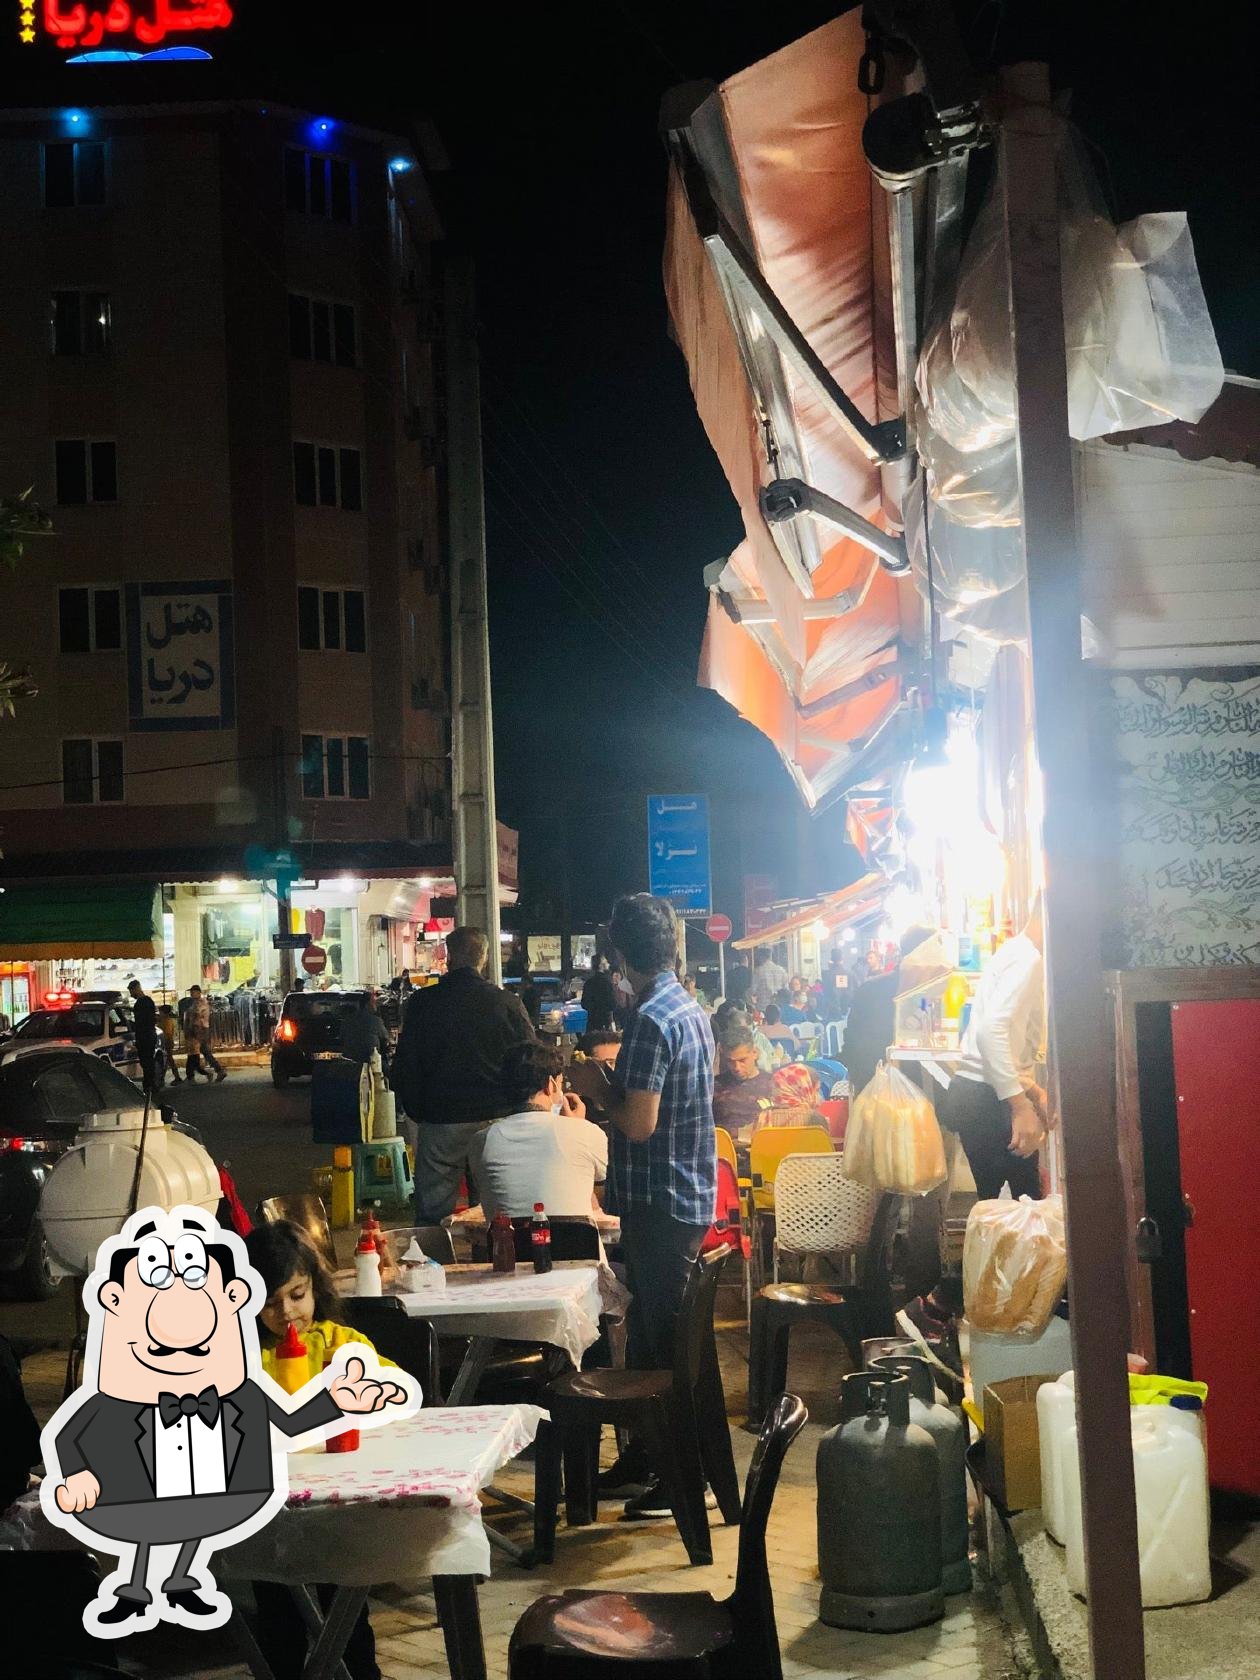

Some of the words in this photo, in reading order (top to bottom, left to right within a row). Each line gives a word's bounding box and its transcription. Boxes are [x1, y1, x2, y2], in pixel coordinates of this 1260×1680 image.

[44, 0, 131, 48] دریا
[146, 603, 214, 650] هتل
[148, 658, 215, 705] دریا
